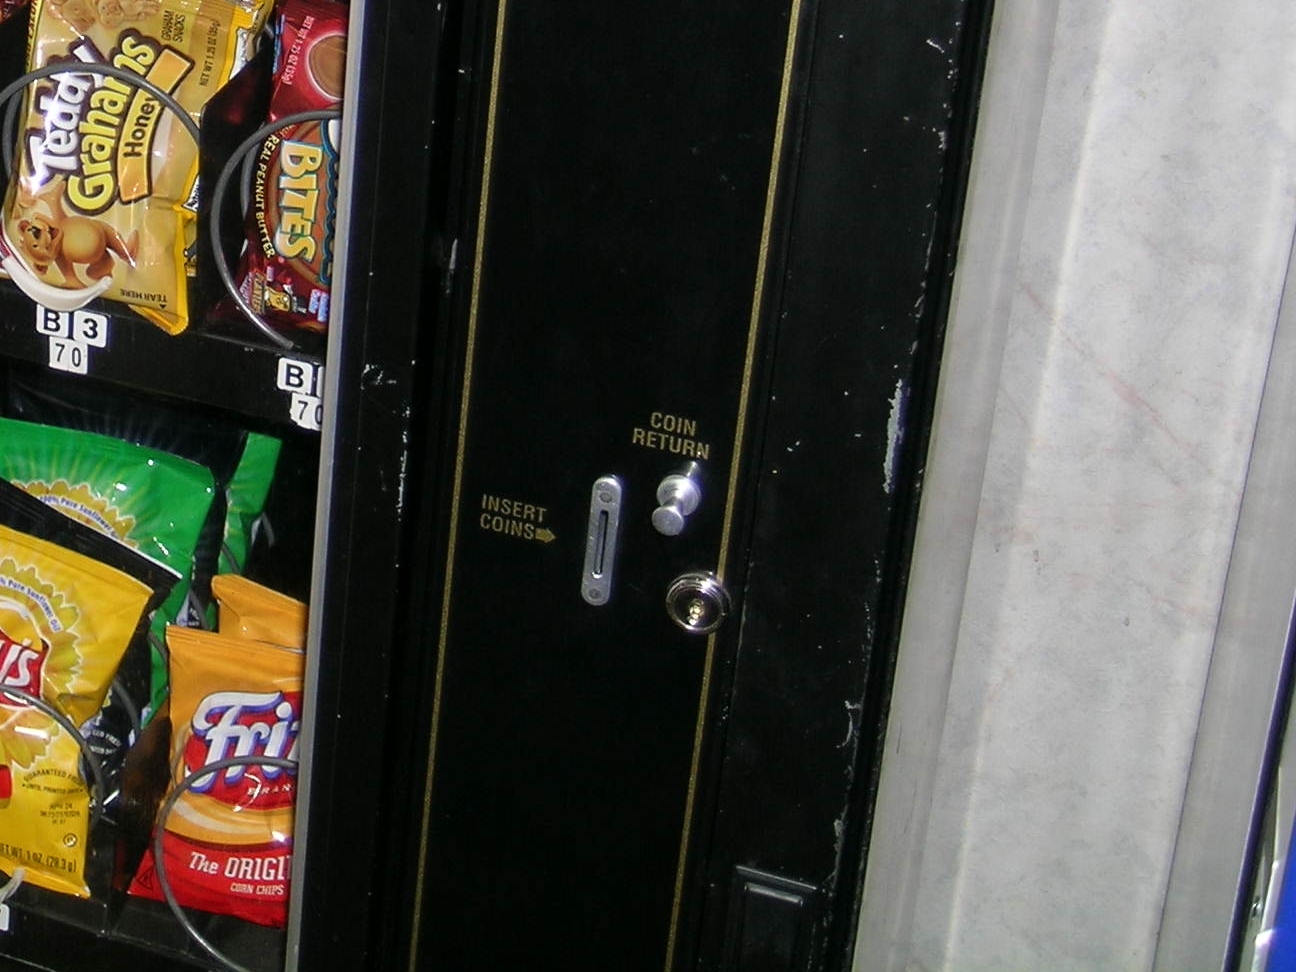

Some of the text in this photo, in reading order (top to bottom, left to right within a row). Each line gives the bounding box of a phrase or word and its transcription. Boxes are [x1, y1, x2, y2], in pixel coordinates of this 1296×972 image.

[255, 134, 281, 259] REAL PEANUT BUTTER
[274, 139, 324, 263] BITES
[55, 343, 82, 368] 70
[7, 579, 25, 591] Pure
[26, 587, 55, 621] Sunflower
[189, 851, 292, 881] The ORIGI
[230, 881, 285, 897] CORN CHIPS
